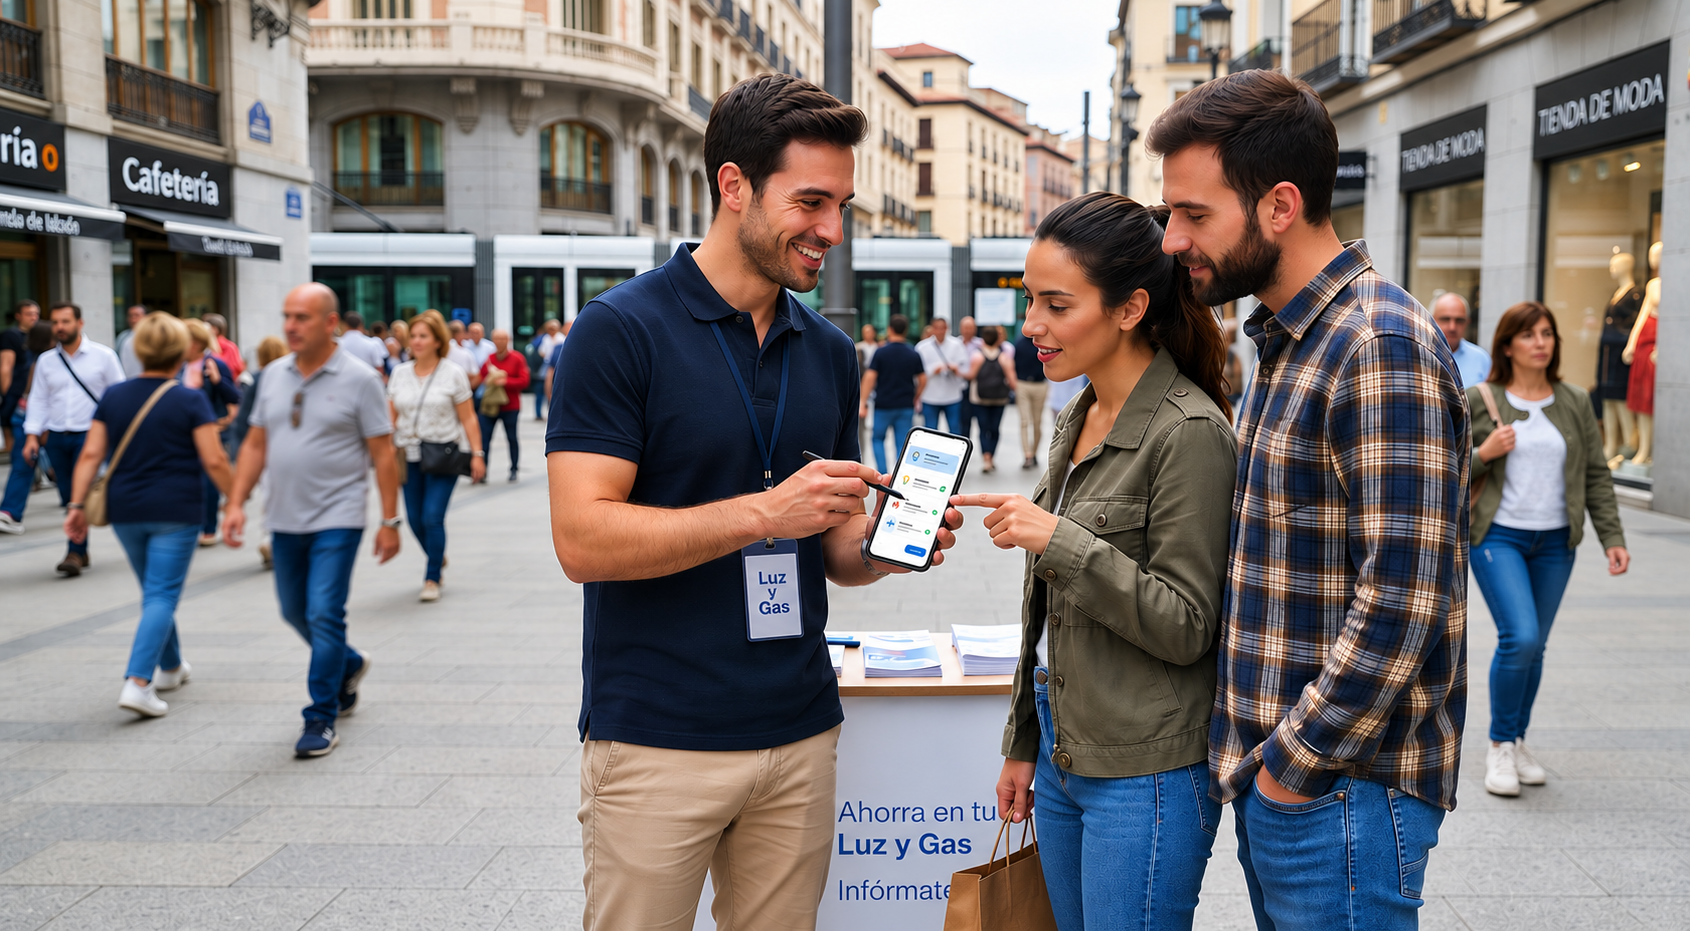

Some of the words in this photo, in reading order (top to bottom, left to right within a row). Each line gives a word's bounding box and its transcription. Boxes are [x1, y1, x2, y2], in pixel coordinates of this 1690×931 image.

[1538, 97, 1588, 137] TIENDA
[1589, 89, 1612, 123] DE
[1613, 73, 1664, 116] MODA
[122, 156, 219, 206] Cafetería
[758, 571, 787, 585] Luz
[767, 588, 777, 600] y
[758, 601, 790, 615] Gas
[838, 801, 926, 823] Ahorra
[933, 806, 964, 822] en
[971, 802, 996, 821] tu
[838, 833, 887, 855] Luz
[895, 838, 911, 860] y
[918, 832, 972, 855] Gas
